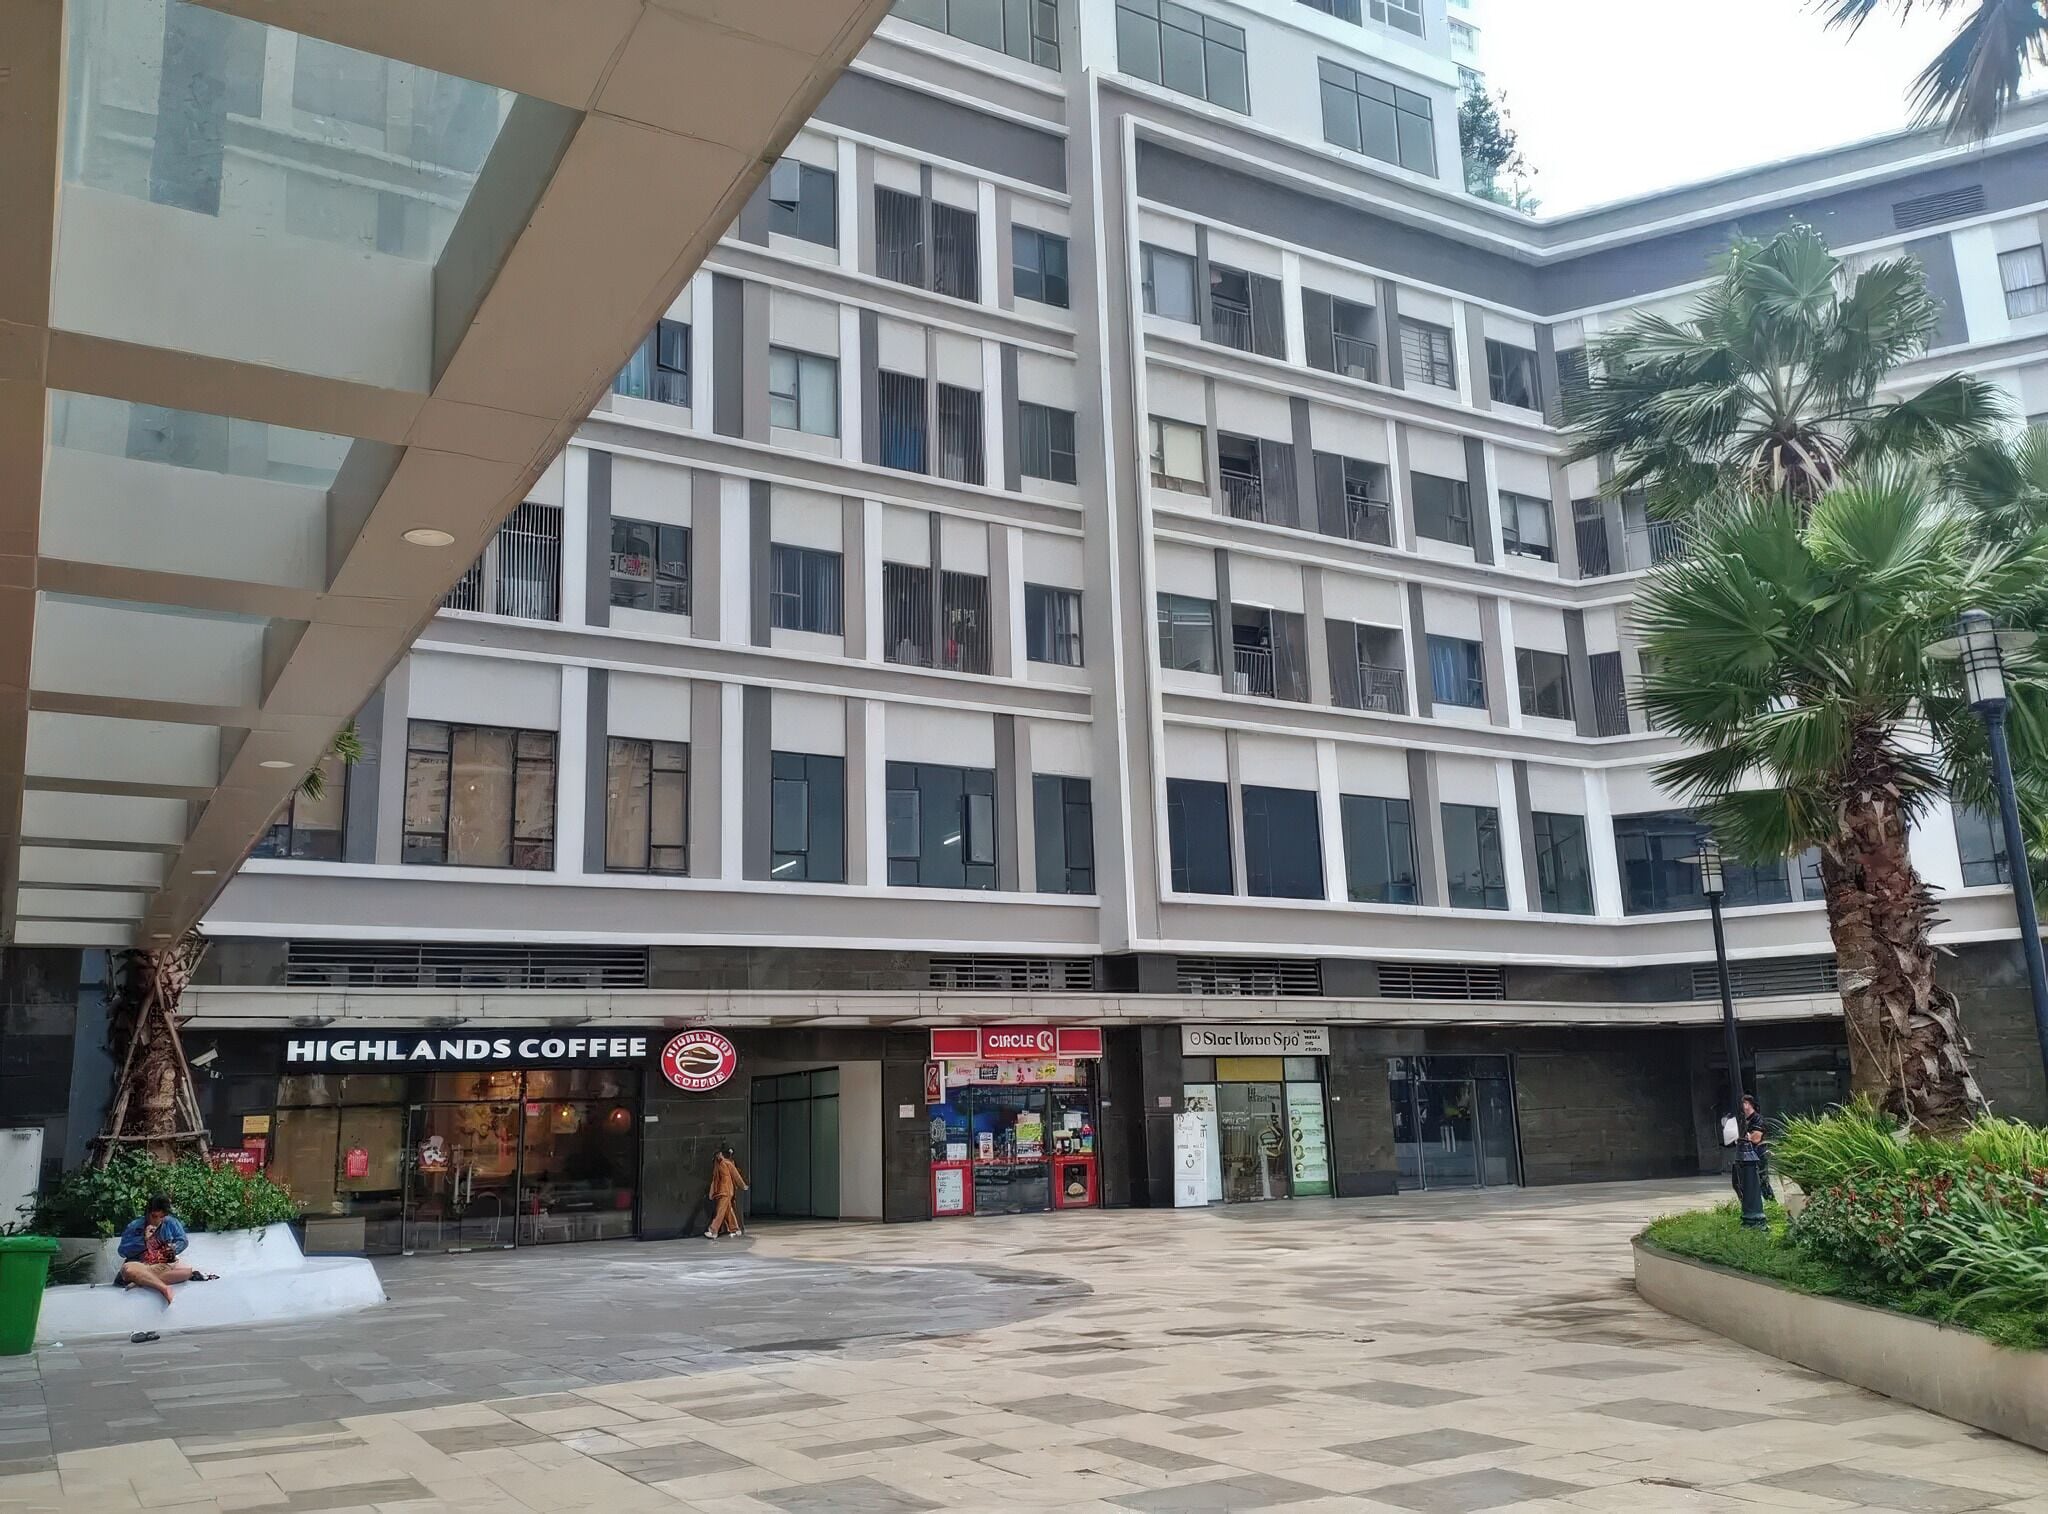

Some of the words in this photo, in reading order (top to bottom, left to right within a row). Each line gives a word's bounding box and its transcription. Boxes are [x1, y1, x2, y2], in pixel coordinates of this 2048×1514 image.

[286, 1038, 512, 1063] HIGHLANDS
[517, 1037, 647, 1060] COFFEE
[989, 1034, 1035, 1048] CIRCLE
[1038, 1031, 1053, 1050] K
